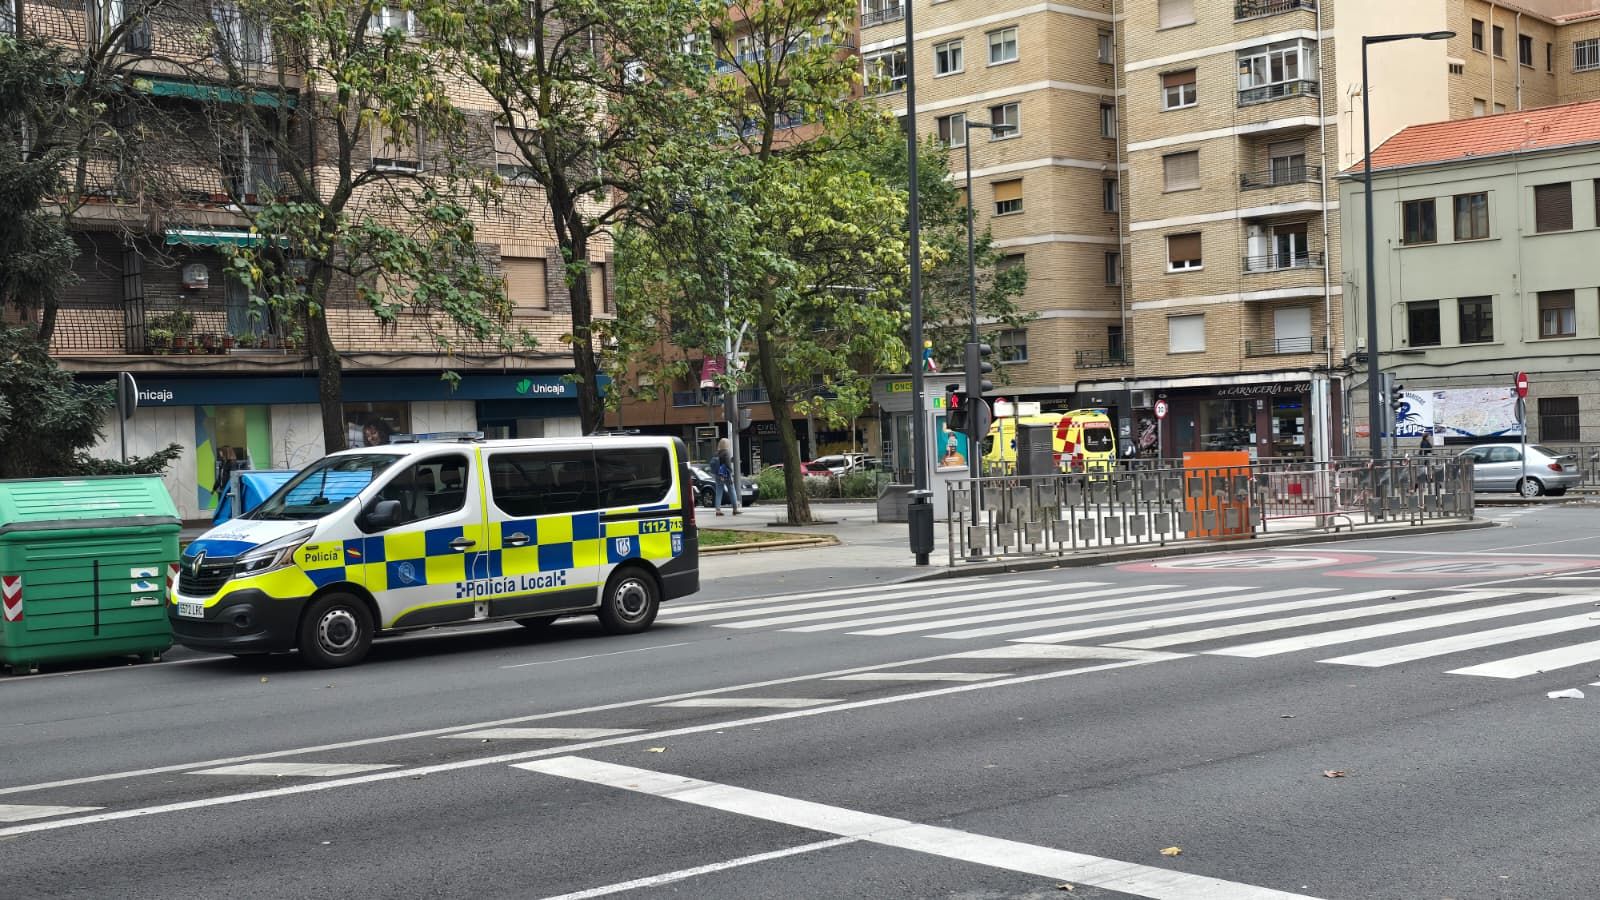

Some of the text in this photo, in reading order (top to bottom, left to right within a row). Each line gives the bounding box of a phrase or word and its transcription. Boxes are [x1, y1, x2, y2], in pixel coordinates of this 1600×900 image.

[138, 389, 173, 402] nicaja
[532, 384, 565, 395] Unicaja
[646, 520, 667, 533] 112
[304, 549, 338, 563] Policía
[466, 571, 557, 597] Policía Local
